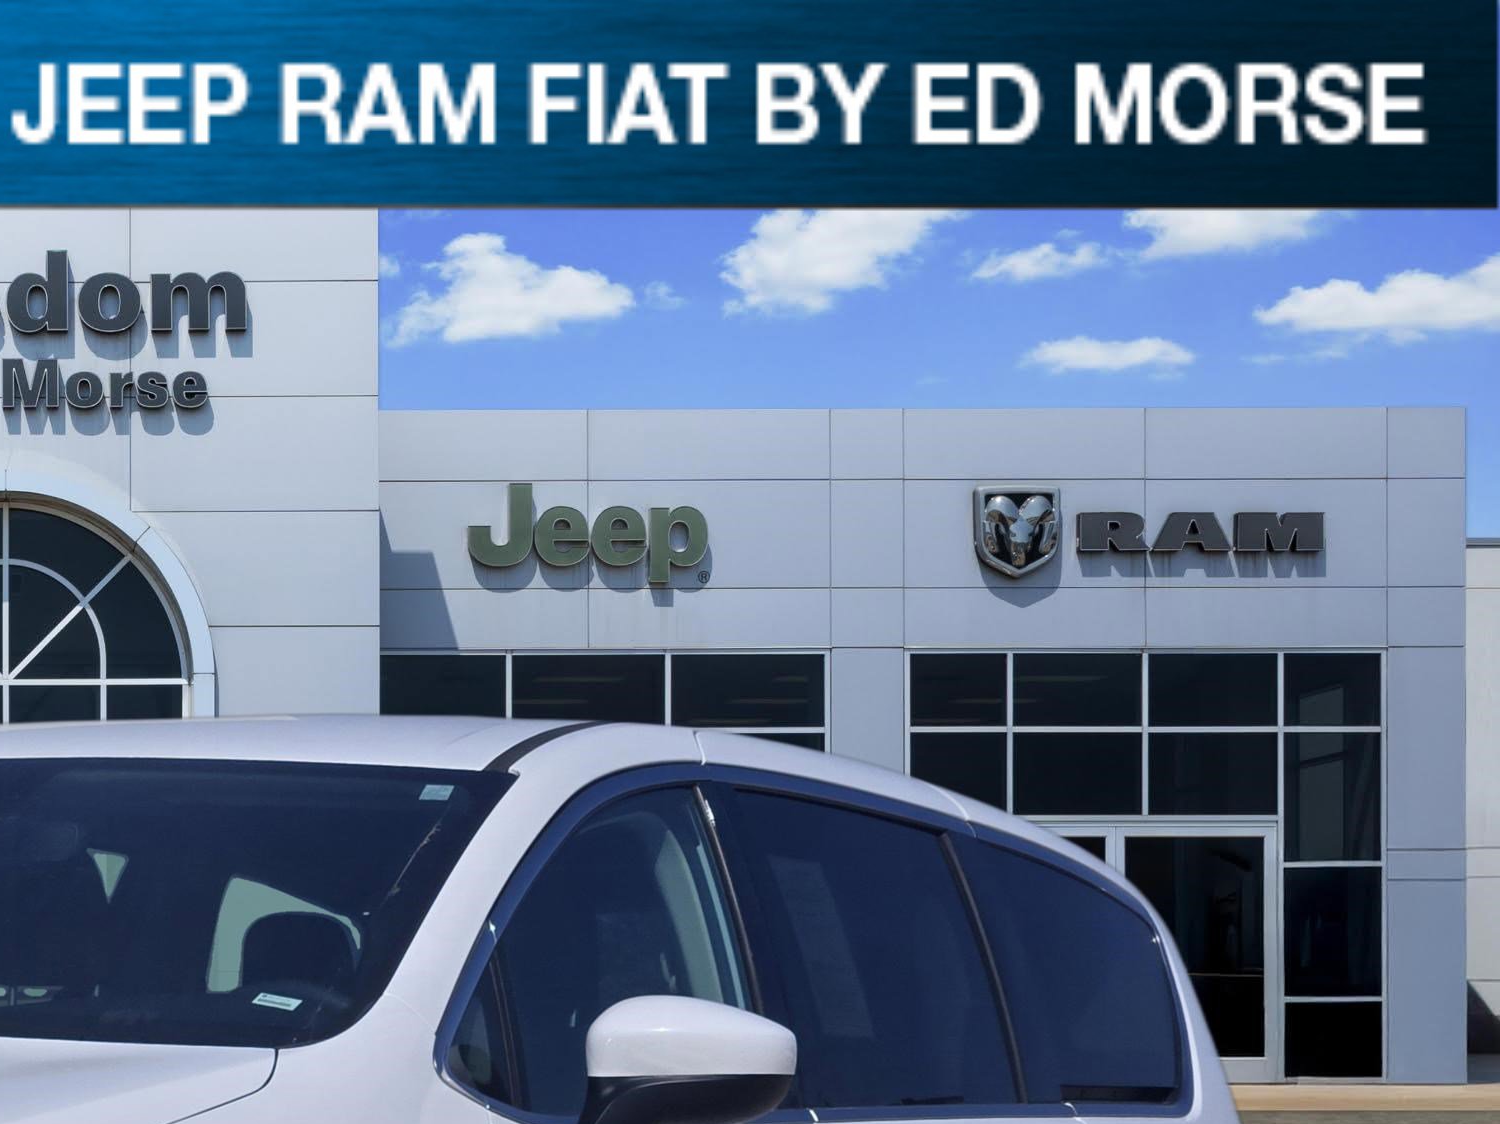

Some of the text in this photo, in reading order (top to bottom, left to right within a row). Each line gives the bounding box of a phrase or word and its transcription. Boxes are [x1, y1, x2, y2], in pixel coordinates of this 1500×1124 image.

[2, 357, 209, 409] Morse
[466, 482, 709, 584] Jeep
[1075, 511, 1326, 552] RAM
